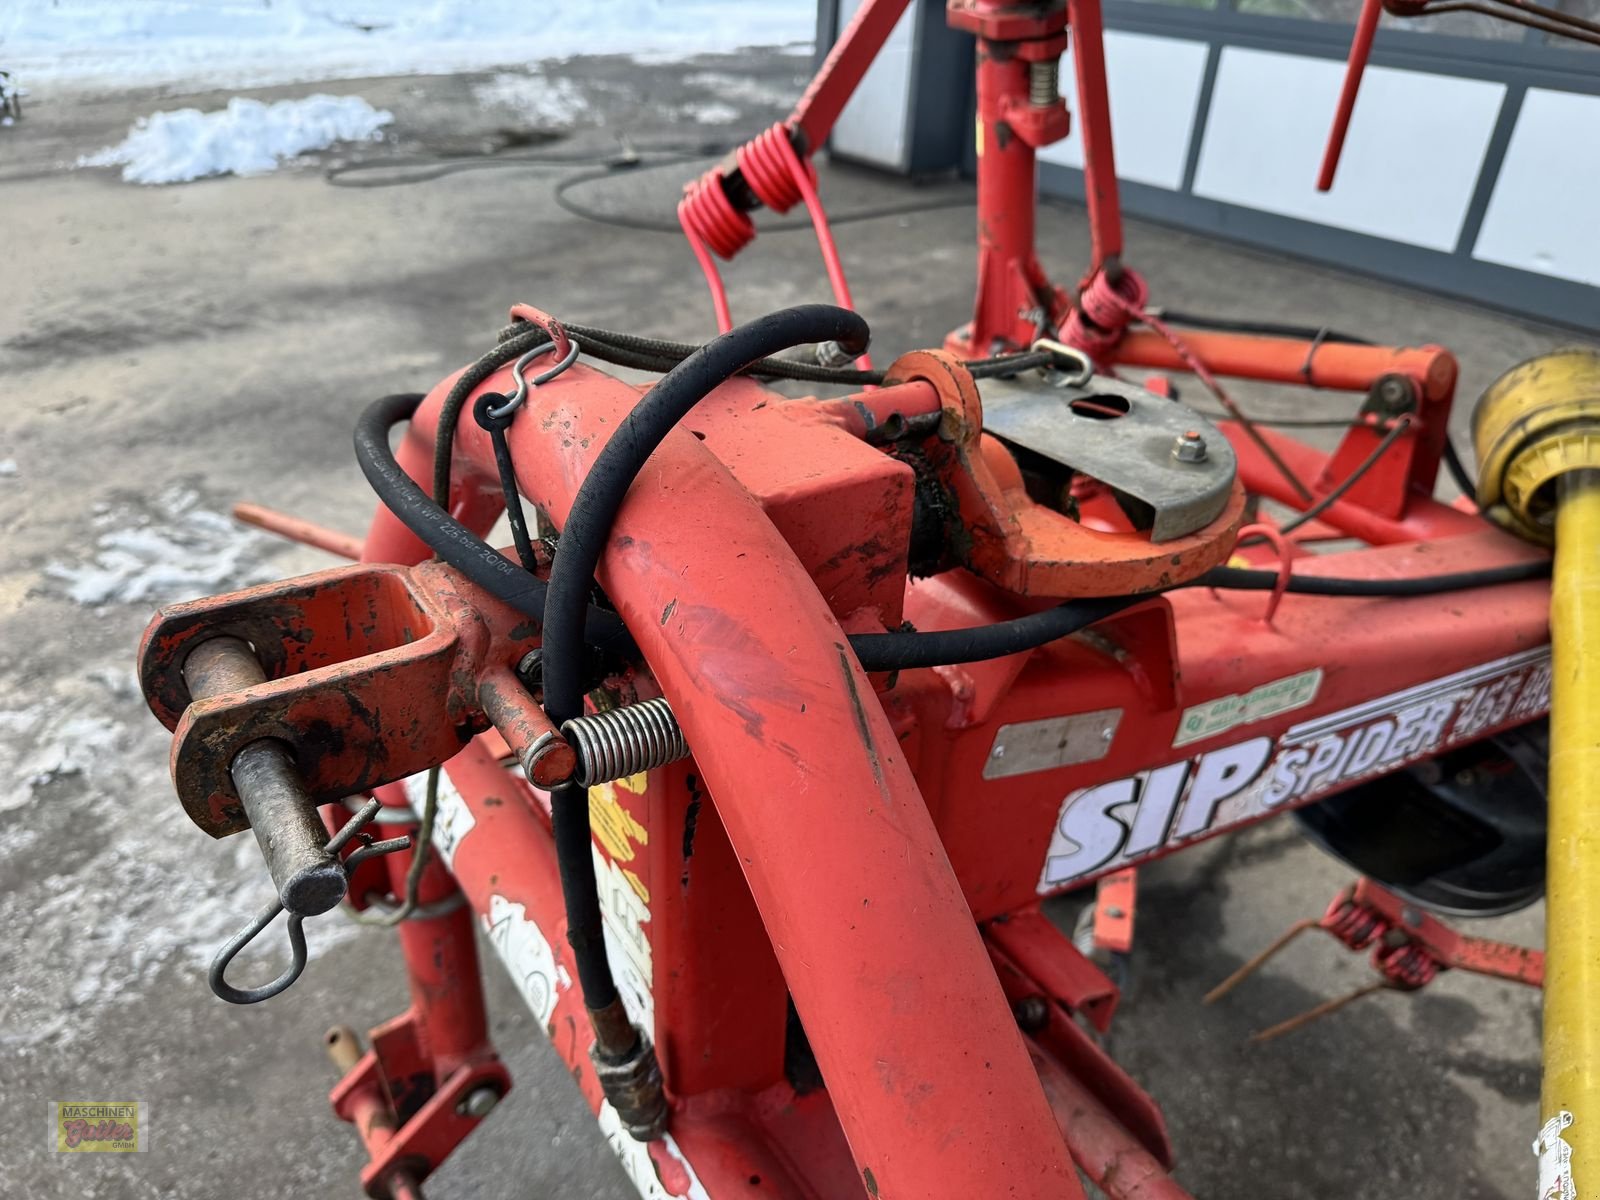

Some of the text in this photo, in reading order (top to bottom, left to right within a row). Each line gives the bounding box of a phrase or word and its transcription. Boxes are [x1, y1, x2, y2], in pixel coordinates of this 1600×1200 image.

[422, 505, 442, 522] WP
[440, 521, 460, 539] 225
[459, 535, 481, 552] bar
[1045, 736, 1274, 884] SIP
[1262, 696, 1456, 809] SPIDER
